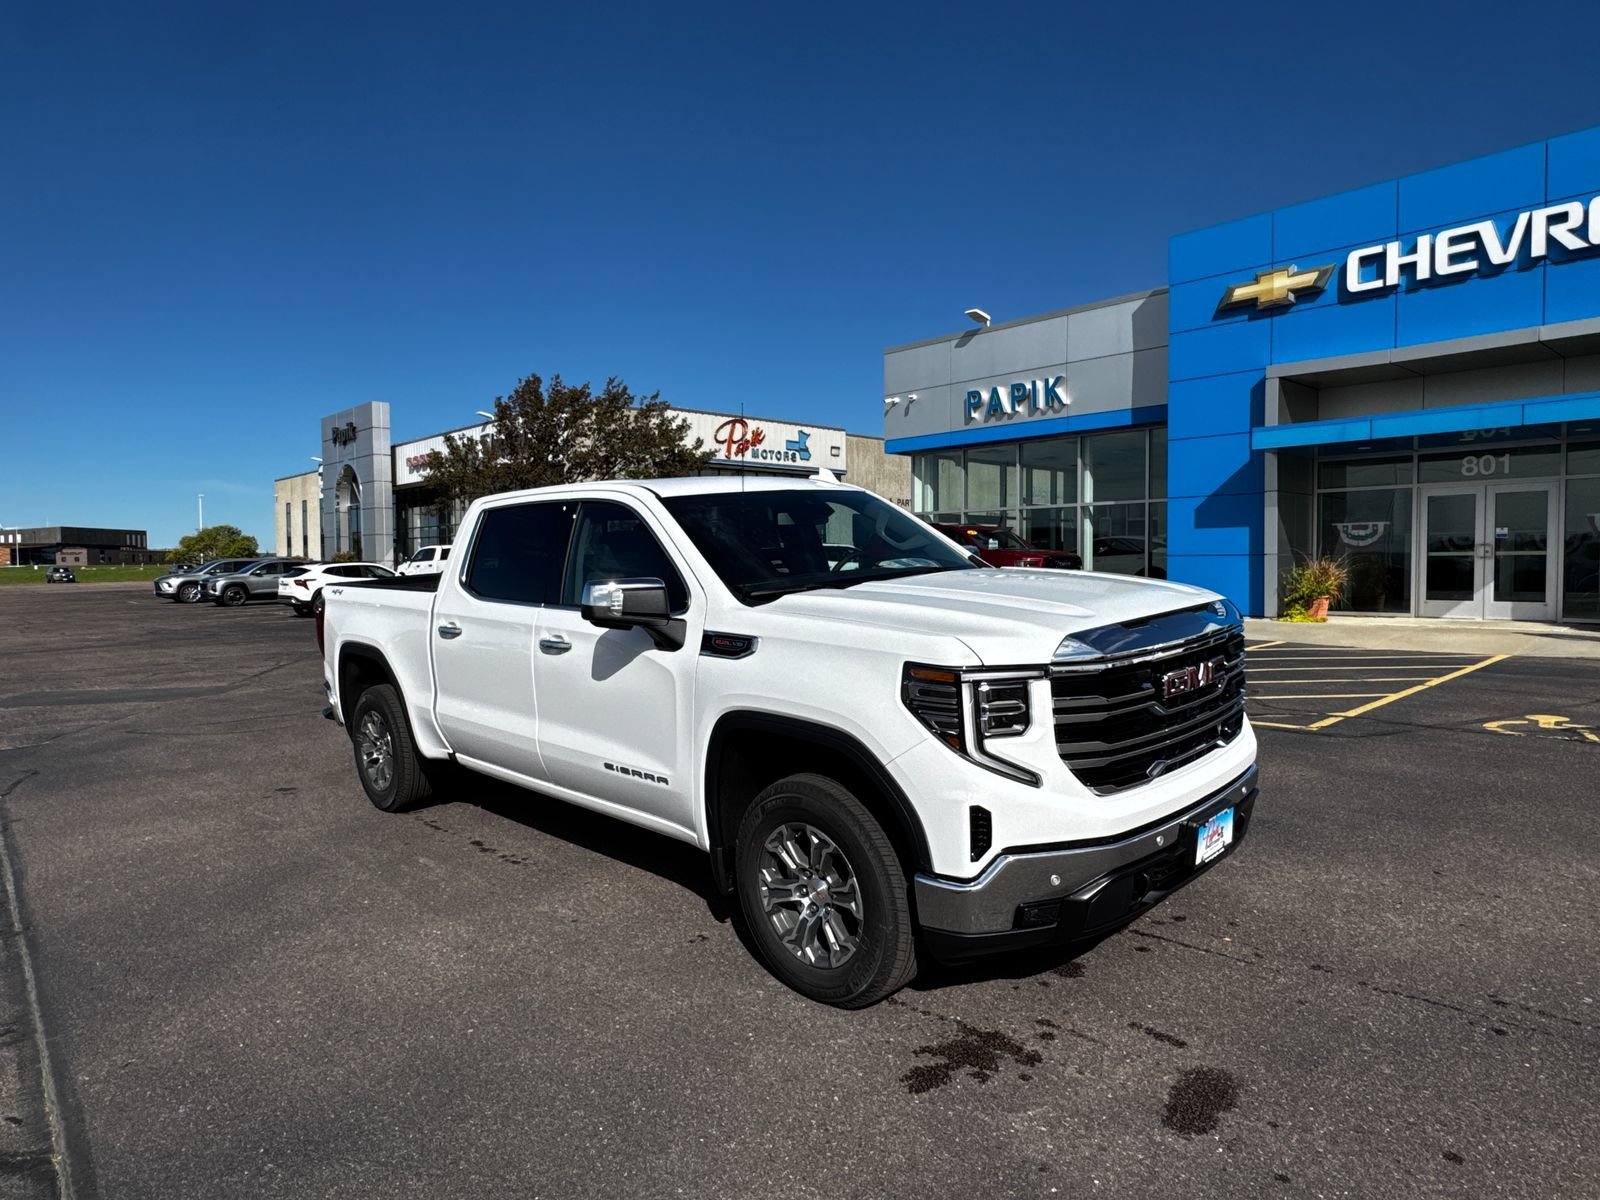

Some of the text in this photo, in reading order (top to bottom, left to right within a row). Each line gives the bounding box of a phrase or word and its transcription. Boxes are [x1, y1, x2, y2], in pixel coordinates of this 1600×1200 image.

[1346, 195, 1600, 293] CHEVR
[965, 375, 1068, 420] PAPIK
[751, 447, 797, 463] MOTORS
[1461, 453, 1511, 476] 801
[896, 498, 911, 507] PAR
[1162, 655, 1226, 698] GMC
[603, 762, 669, 786] SIERRA
